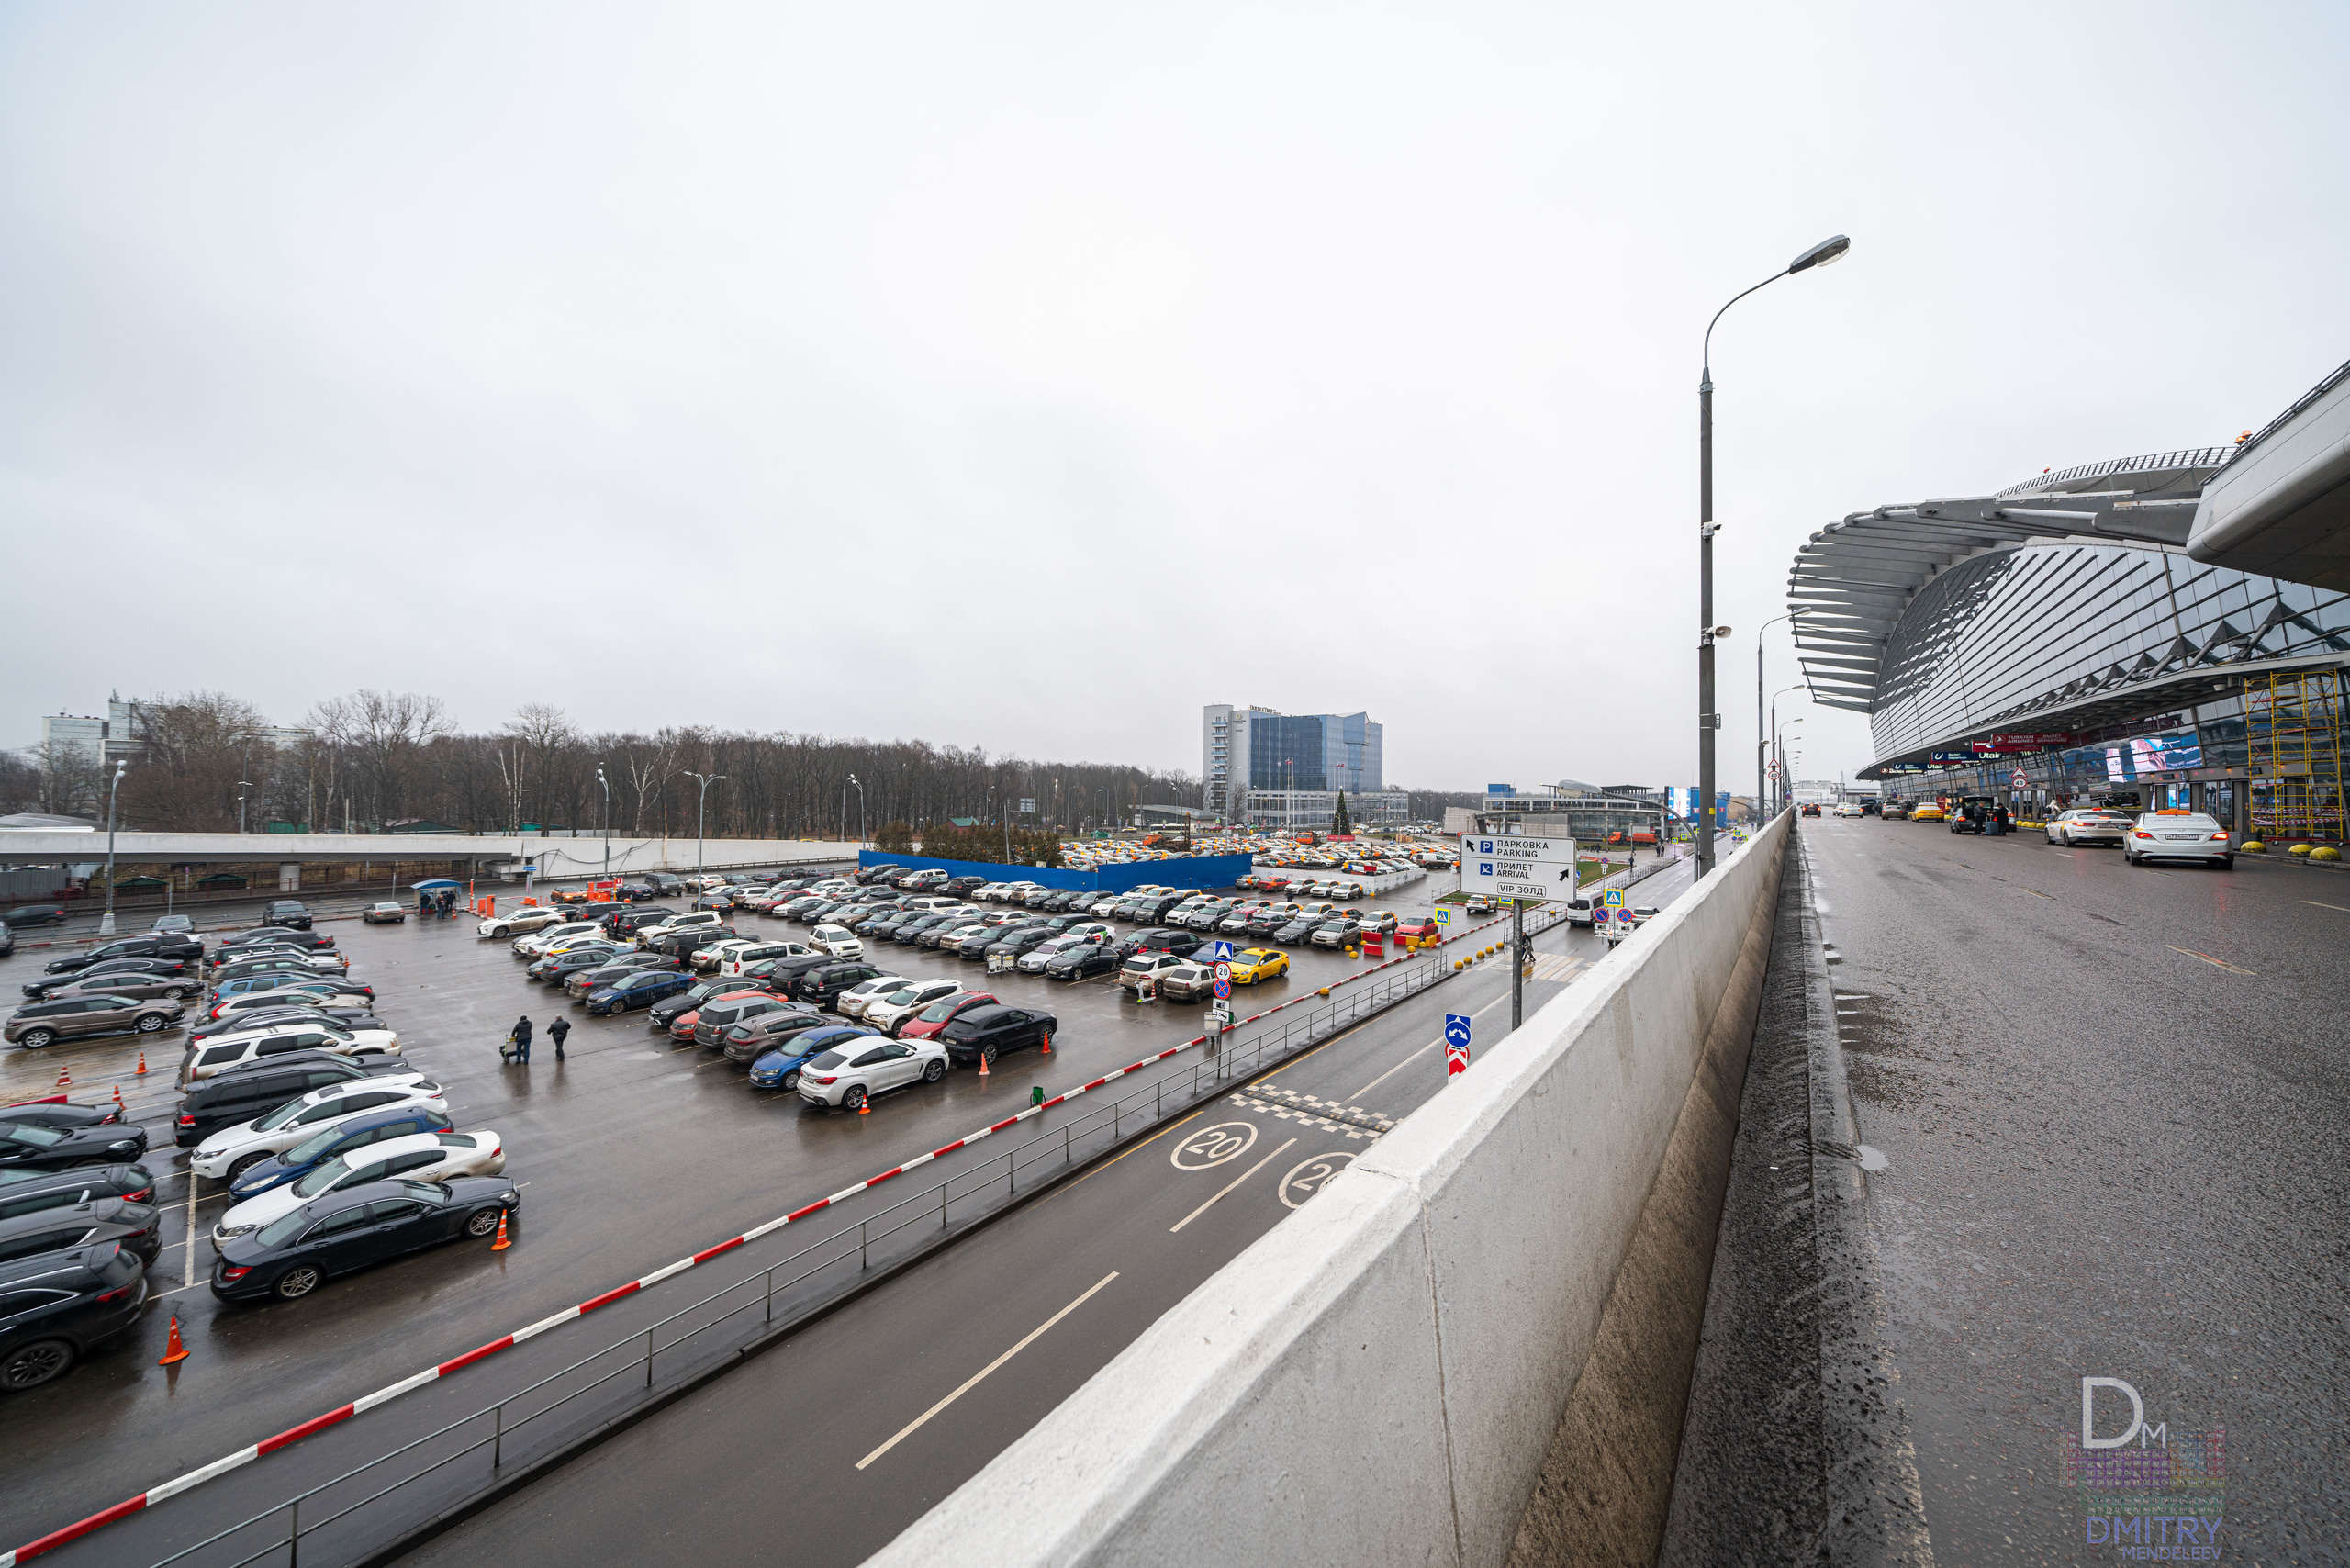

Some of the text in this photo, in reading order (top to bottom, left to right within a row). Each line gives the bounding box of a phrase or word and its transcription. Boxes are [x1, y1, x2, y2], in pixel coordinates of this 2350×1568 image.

[1483, 842, 1491, 852] P
[1497, 840, 1549, 849] ПАРКОВКА
[1497, 849, 1538, 857] PARKING
[1497, 862, 1534, 871] ПРИЛЕТ
[1497, 870, 1530, 879] ARRIVAL
[1500, 884, 1515, 893] VIP
[1218, 967, 1228, 976] 20
[1185, 1130, 1243, 1159] 20
